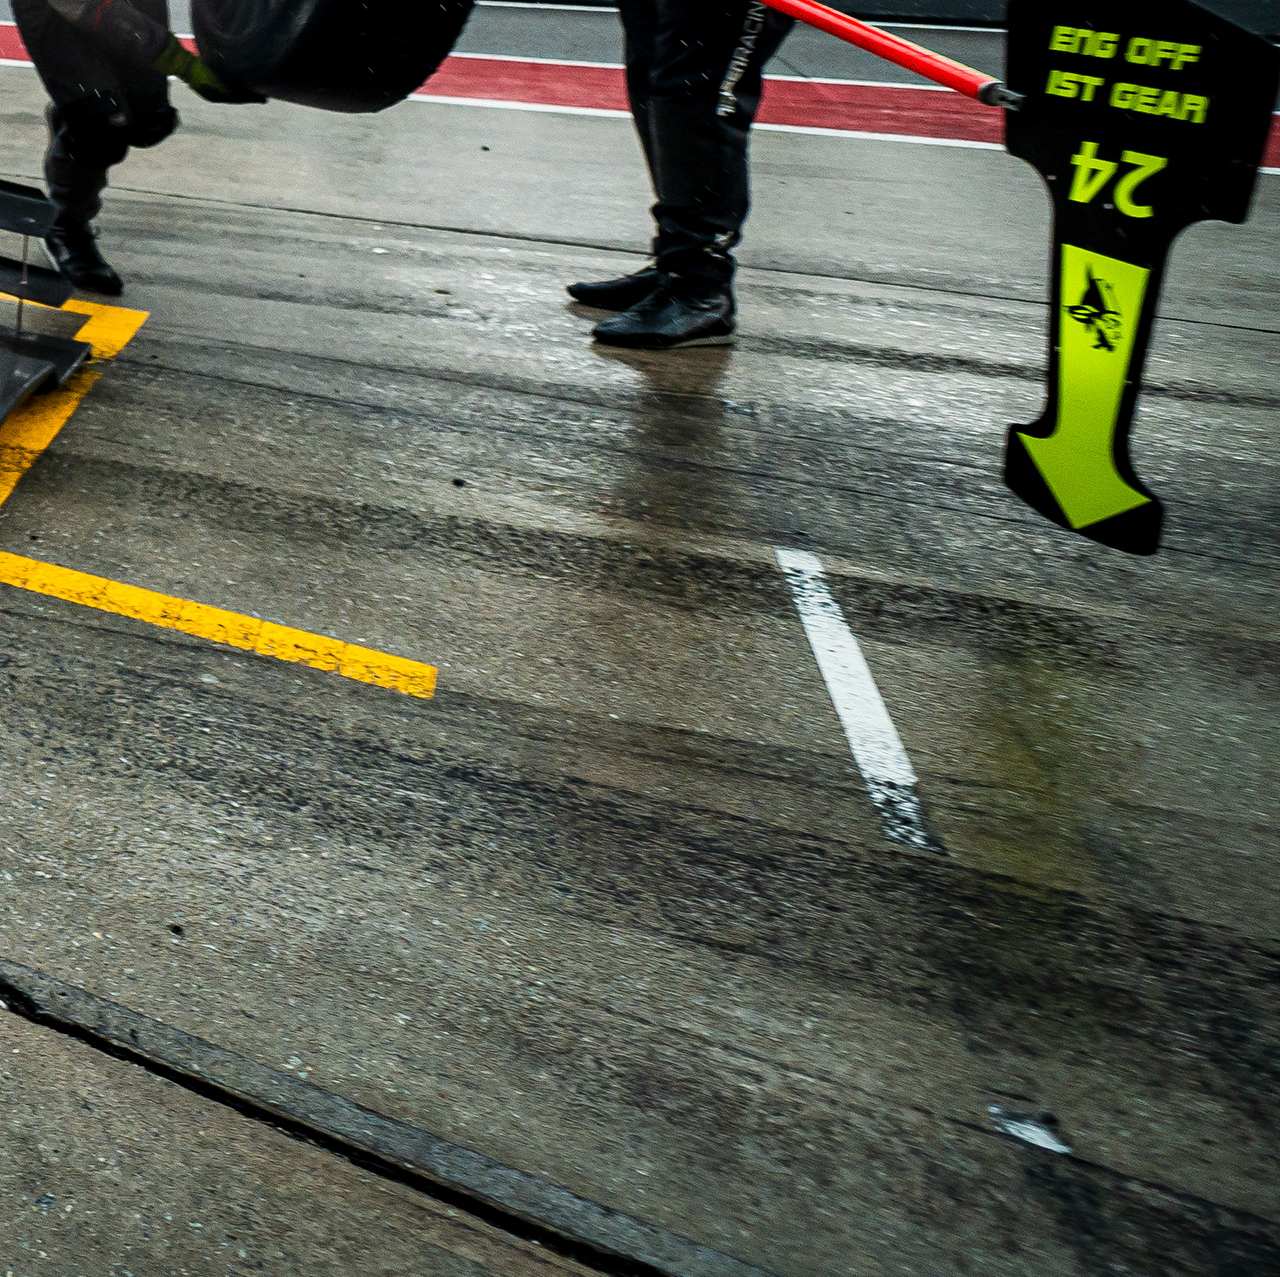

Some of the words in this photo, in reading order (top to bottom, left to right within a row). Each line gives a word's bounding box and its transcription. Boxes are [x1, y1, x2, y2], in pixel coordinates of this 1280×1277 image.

[1048, 25, 1121, 58] ENG
[1124, 36, 1203, 70] OFF
[1109, 82, 1210, 124] GEAR
[1068, 141, 1169, 218] 24
